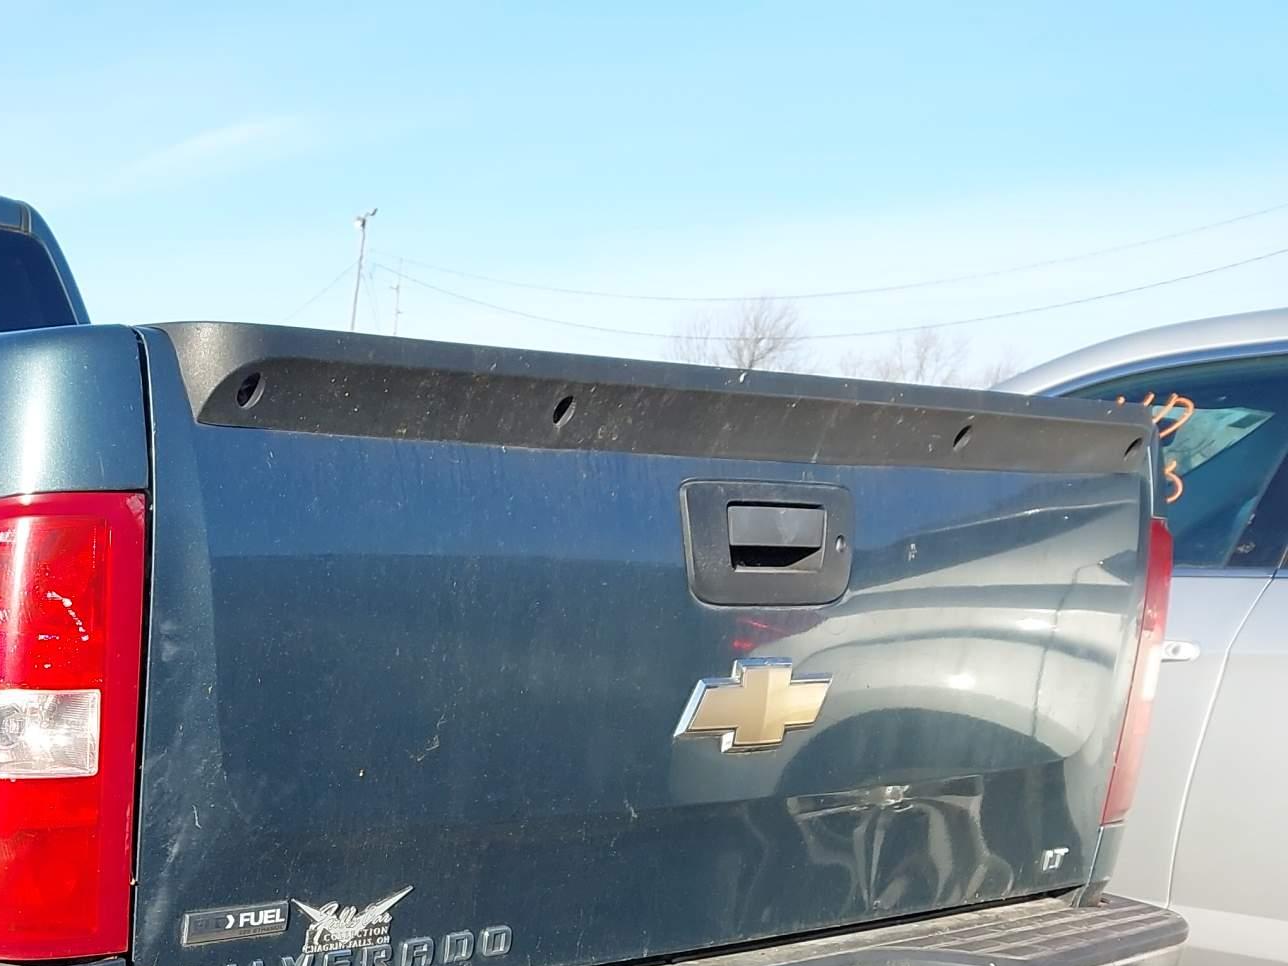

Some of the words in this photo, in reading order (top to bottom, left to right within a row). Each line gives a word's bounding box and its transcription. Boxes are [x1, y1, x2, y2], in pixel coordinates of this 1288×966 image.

[239, 908, 285, 927] FUEL
[323, 926, 389, 943] COCTION
[376, 935, 391, 945] OH
